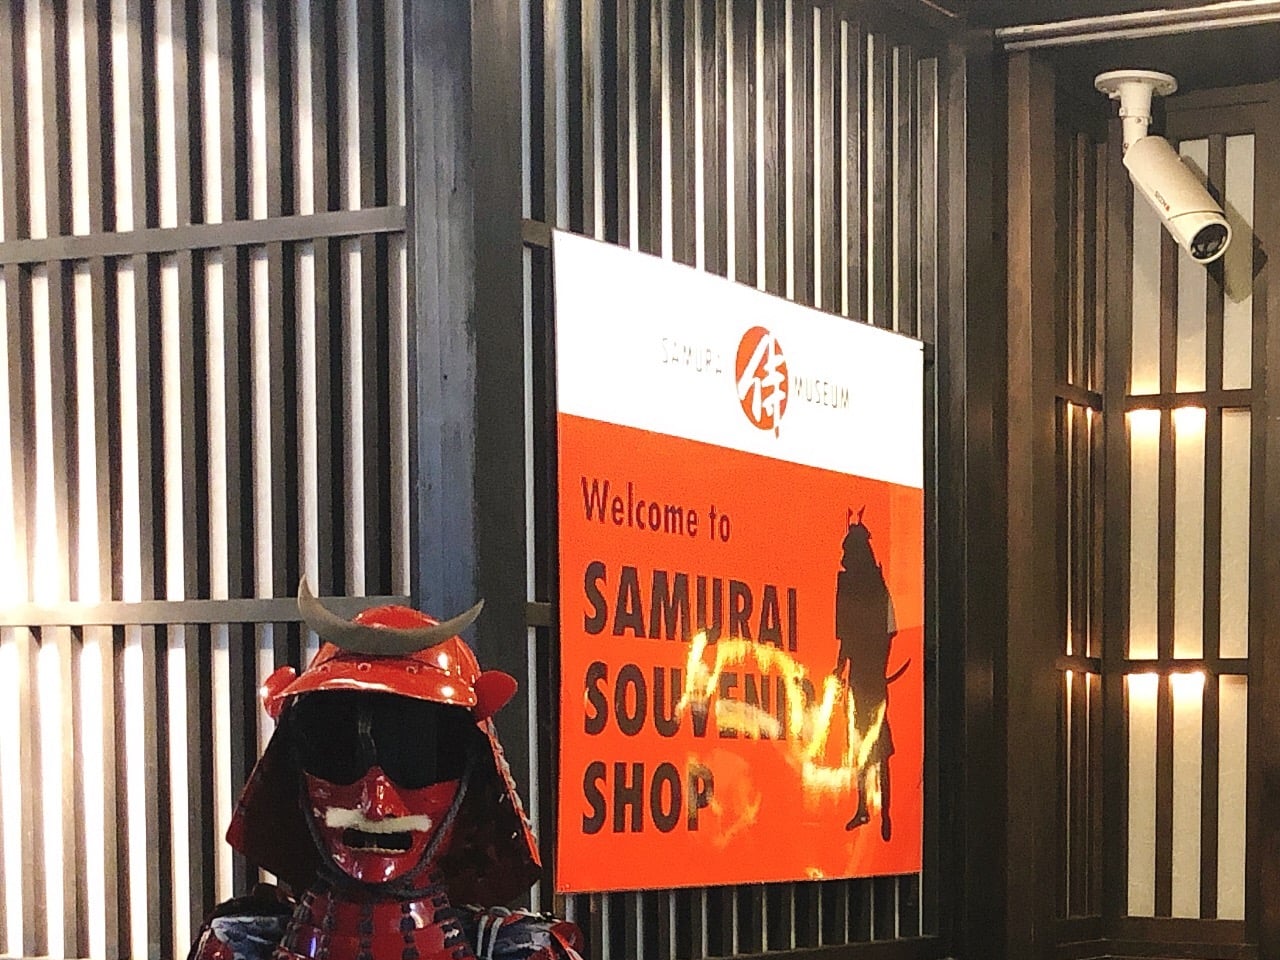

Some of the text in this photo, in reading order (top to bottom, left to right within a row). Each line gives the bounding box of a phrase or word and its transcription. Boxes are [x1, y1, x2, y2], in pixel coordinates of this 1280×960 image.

[661, 337, 723, 374] SAMURA
[794, 376, 850, 409] MUSEUM
[581, 477, 731, 542] Welcome to
[584, 561, 798, 652] SAMURAI
[582, 761, 714, 834] SHOP
